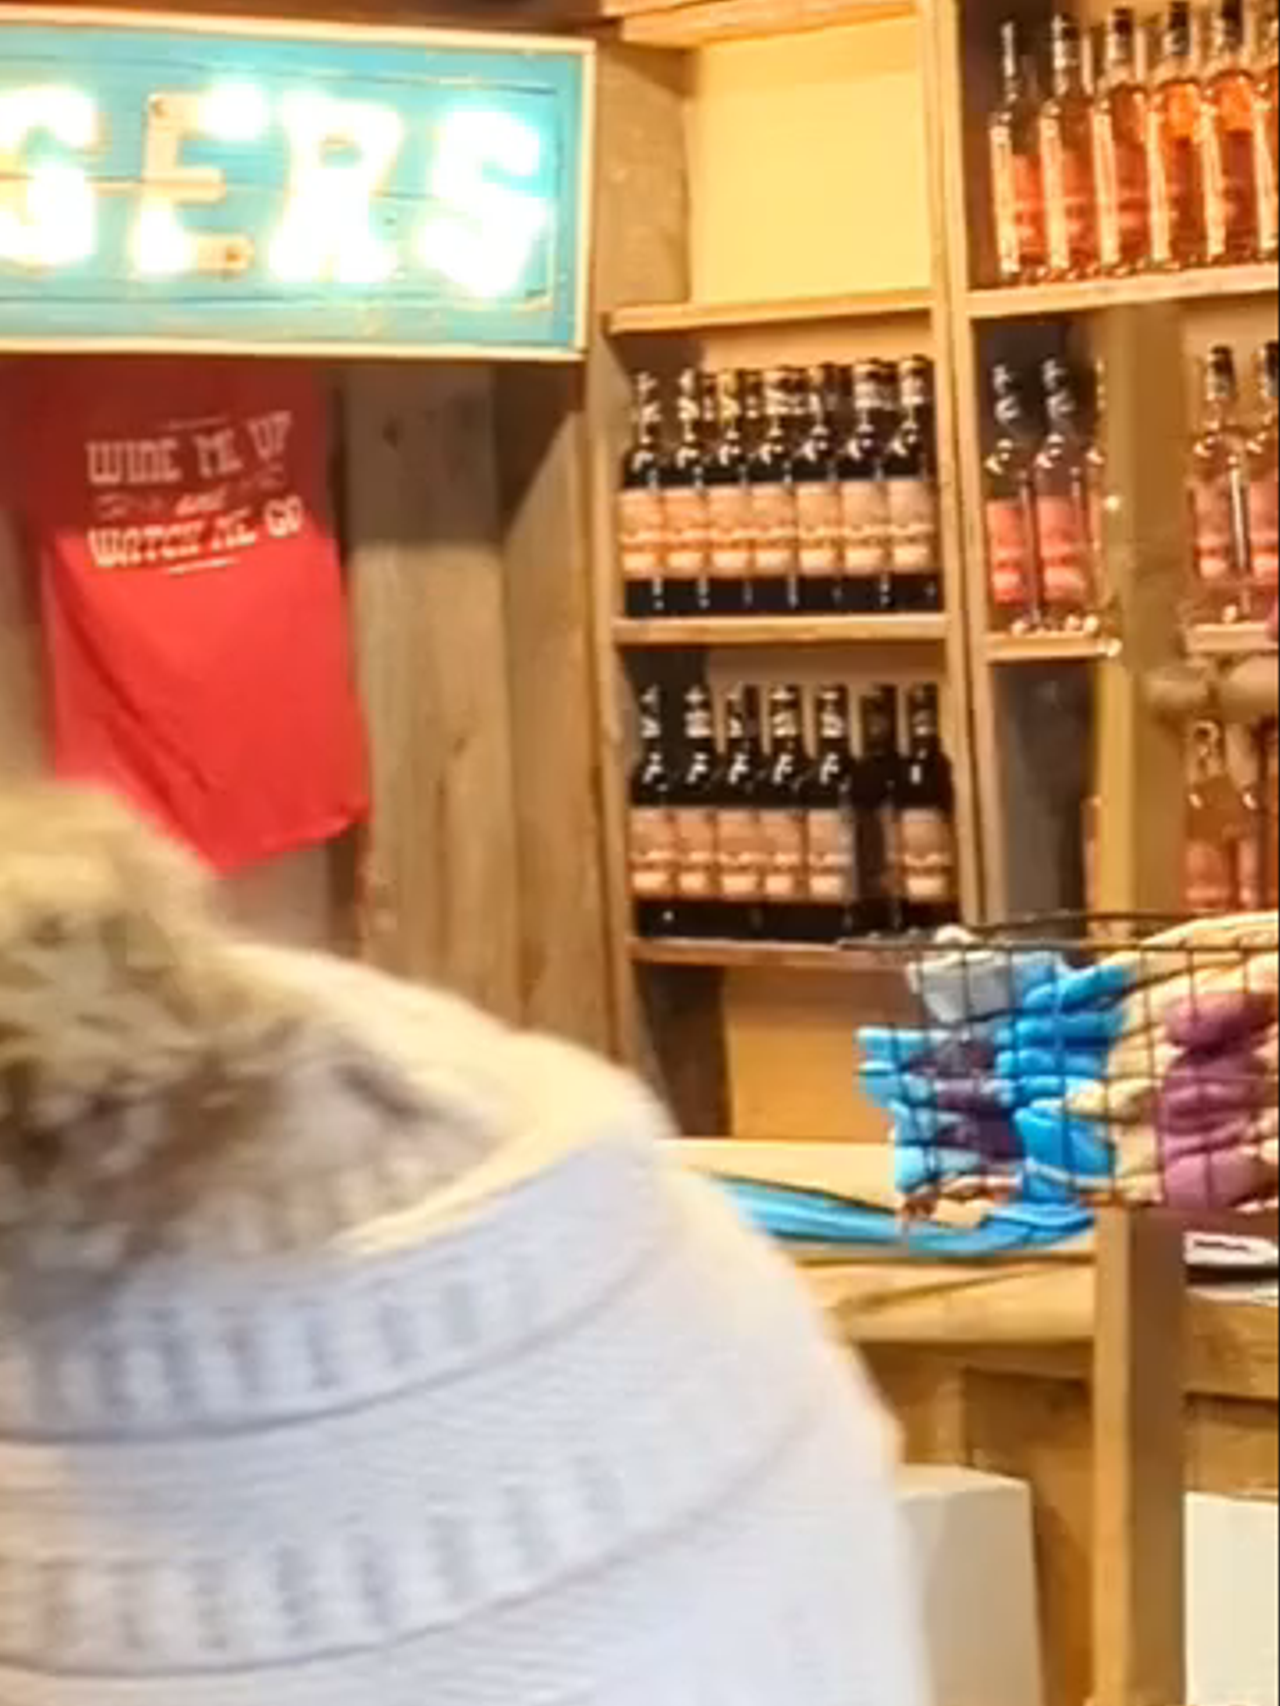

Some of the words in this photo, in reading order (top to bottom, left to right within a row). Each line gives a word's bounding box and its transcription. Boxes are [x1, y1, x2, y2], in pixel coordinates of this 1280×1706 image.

[194, 428, 243, 479] ME
[247, 409, 293, 460] UP
[88, 520, 206, 568] WATCH
[264, 494, 304, 538] GO
